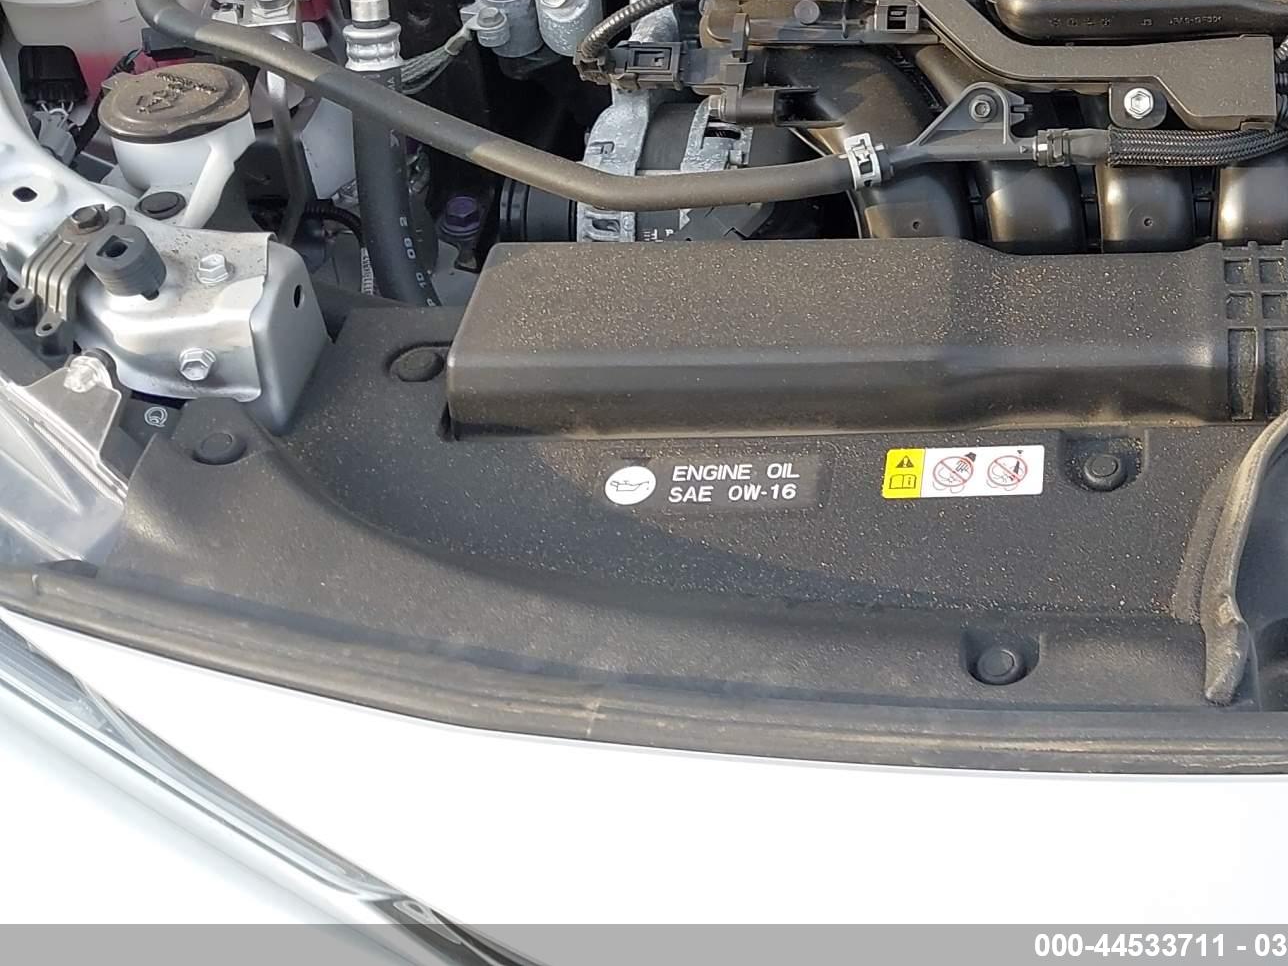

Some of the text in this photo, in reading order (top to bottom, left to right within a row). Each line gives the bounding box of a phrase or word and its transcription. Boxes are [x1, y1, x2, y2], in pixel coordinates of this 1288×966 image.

[672, 463, 800, 481] ENGINE OIL
[668, 483, 797, 503] SAE 0W-16
